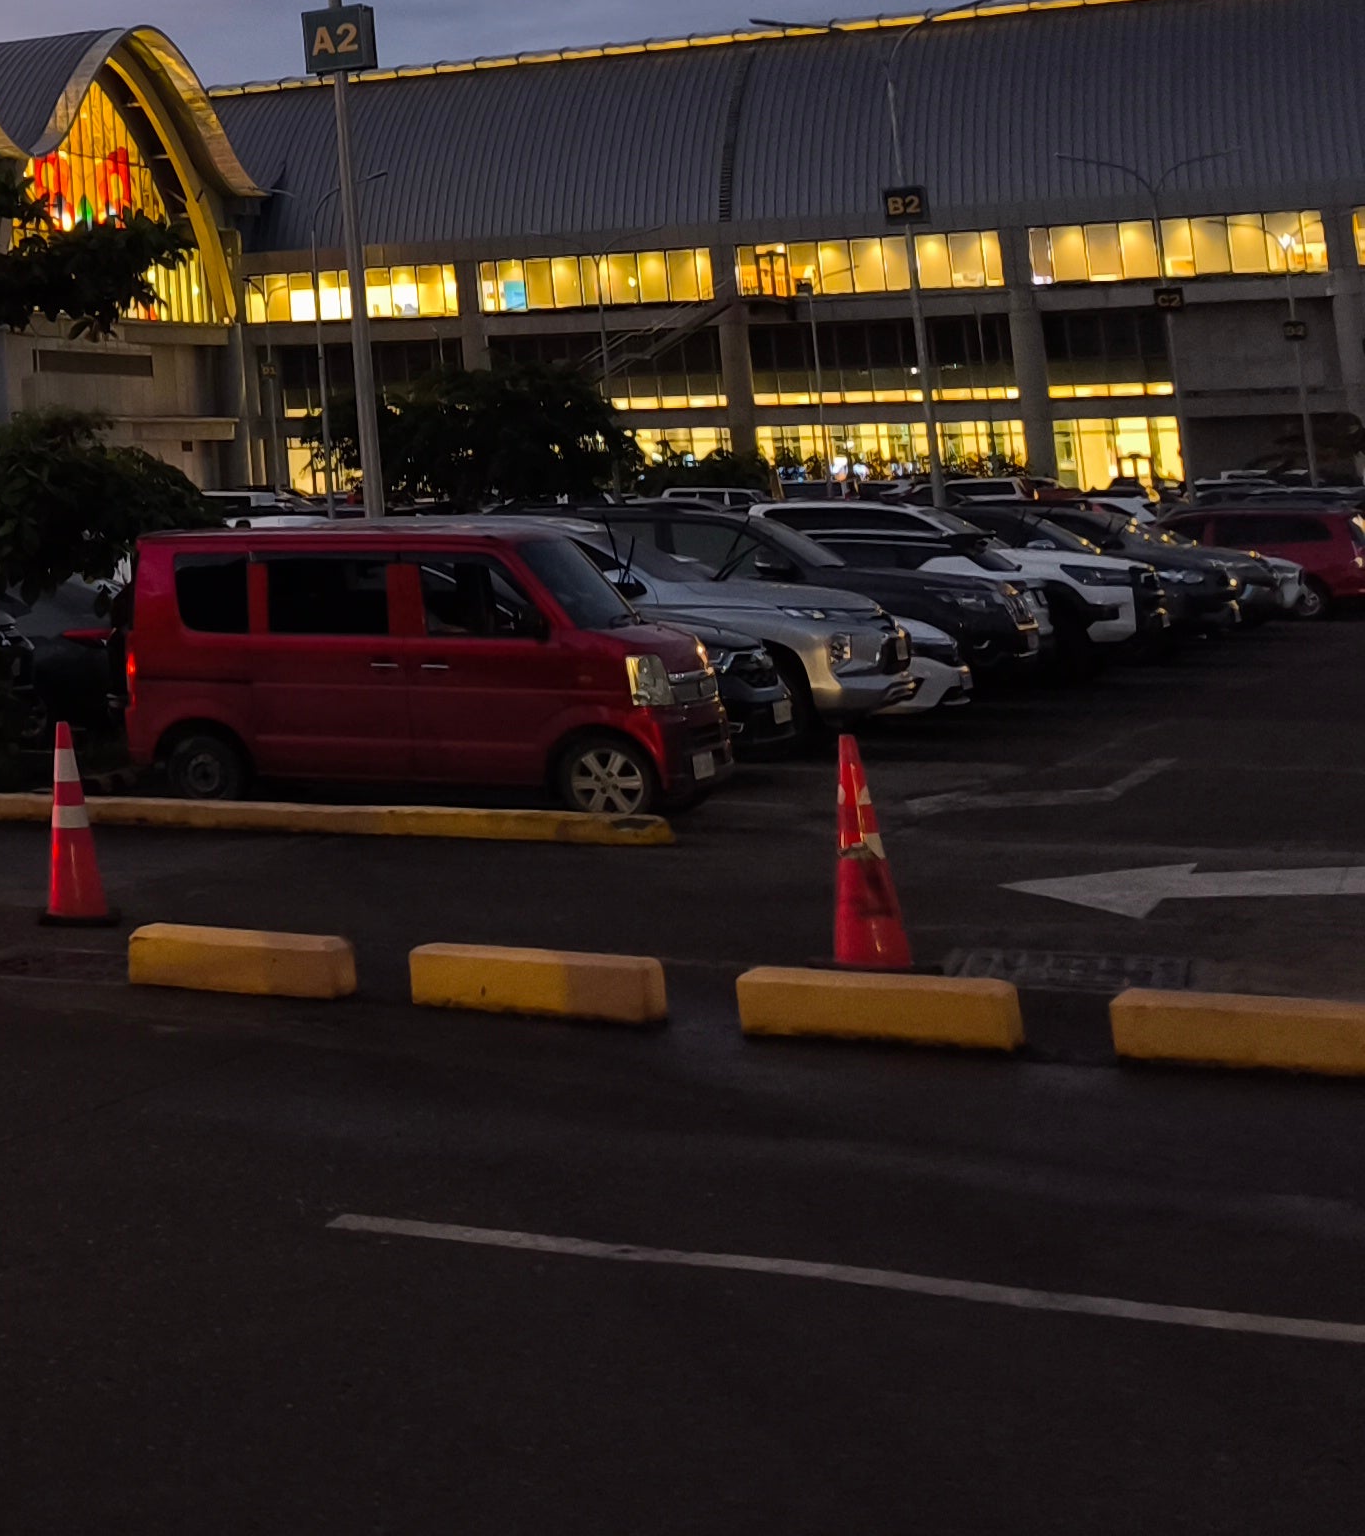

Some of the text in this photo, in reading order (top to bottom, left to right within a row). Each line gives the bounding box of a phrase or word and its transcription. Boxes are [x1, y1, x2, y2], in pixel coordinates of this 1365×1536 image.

[312, 22, 359, 57] A2
[886, 195, 921, 217] B2
[1157, 294, 1181, 308] C2
